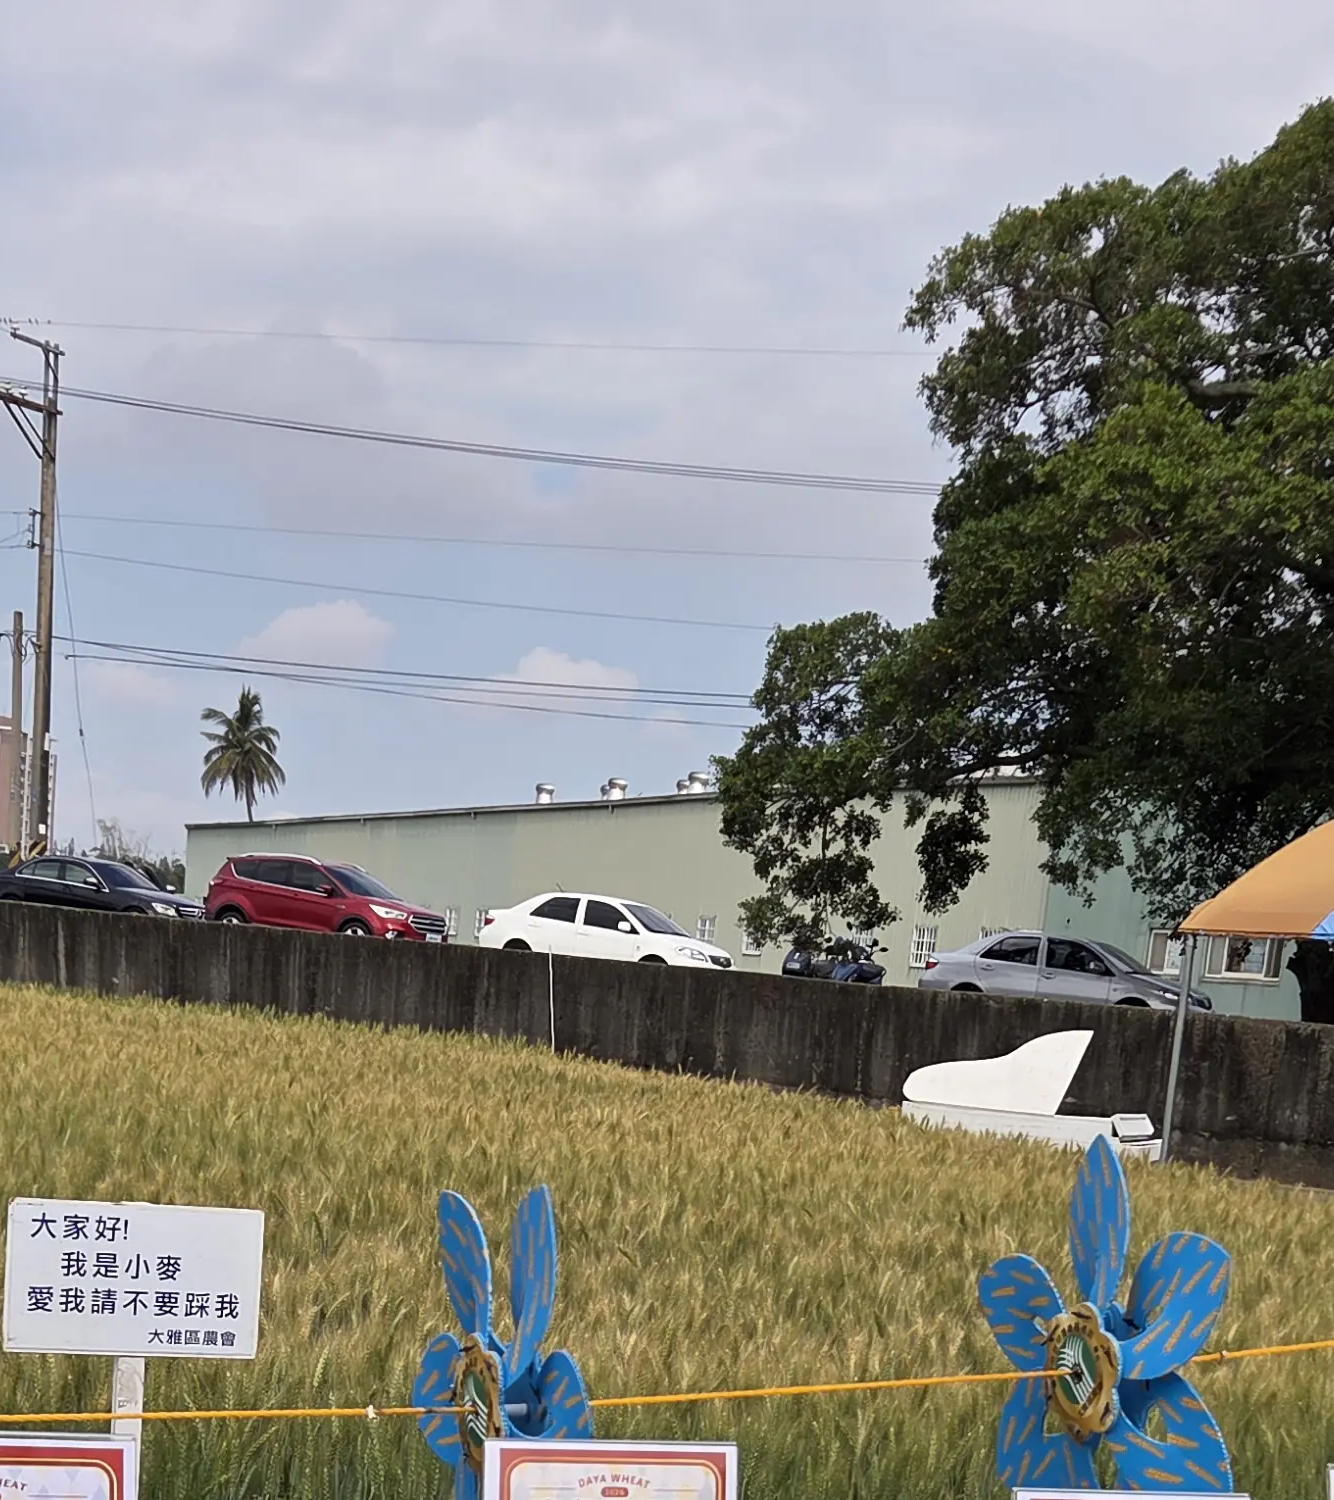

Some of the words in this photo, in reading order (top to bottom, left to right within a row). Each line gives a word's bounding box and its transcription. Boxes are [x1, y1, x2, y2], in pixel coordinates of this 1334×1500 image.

[30, 1212, 129, 1242] 大家好!
[61, 1251, 182, 1281] 我是小麥
[27, 1286, 240, 1319] 愛我請不要踩我
[147, 1329, 236, 1347] 大雅區農會
[578, 1475, 606, 1488] DAYA
[611, 1474, 651, 1488] WHEAT
